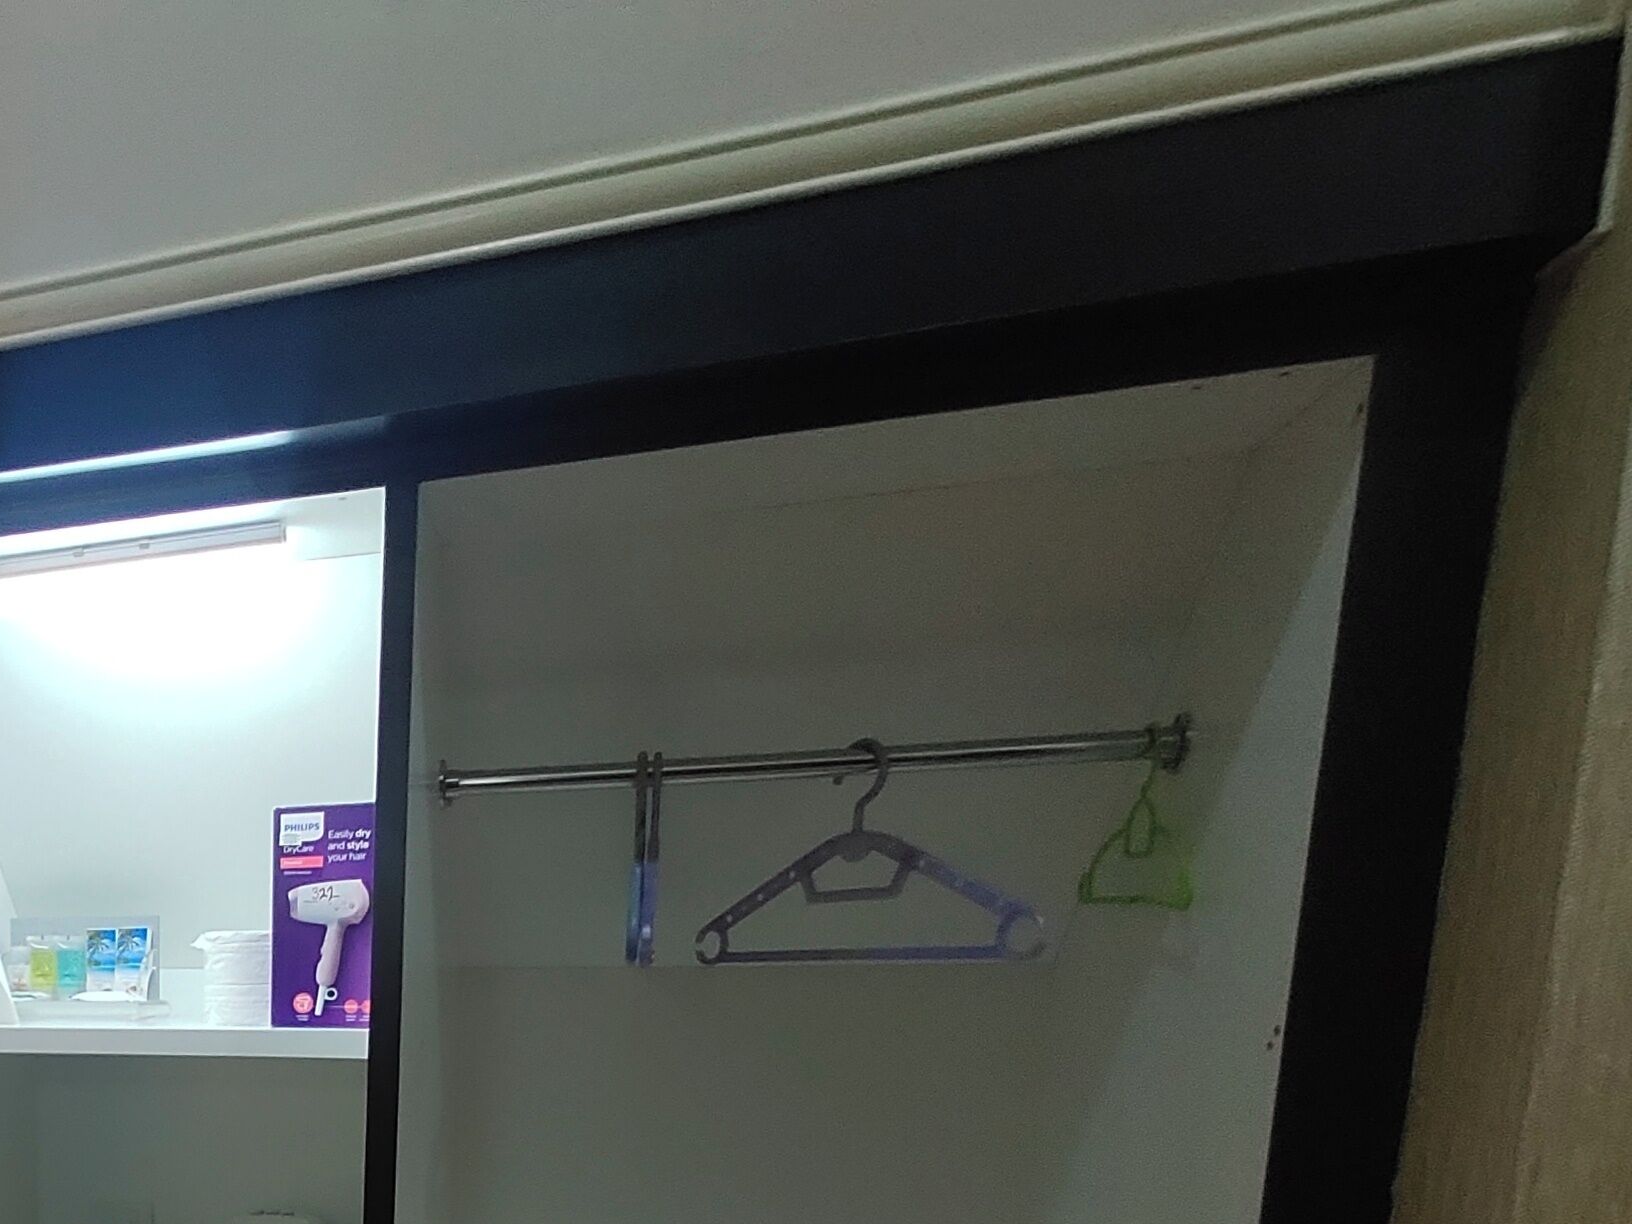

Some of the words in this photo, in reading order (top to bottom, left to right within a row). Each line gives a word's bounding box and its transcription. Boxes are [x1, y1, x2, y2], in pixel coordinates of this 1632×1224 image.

[284, 823, 320, 831] PHILIPS
[328, 829, 354, 840] Easily
[355, 829, 372, 839] dry
[327, 841, 346, 850] and
[347, 840, 369, 850] style
[327, 853, 348, 863] your
[349, 852, 367, 861] hair
